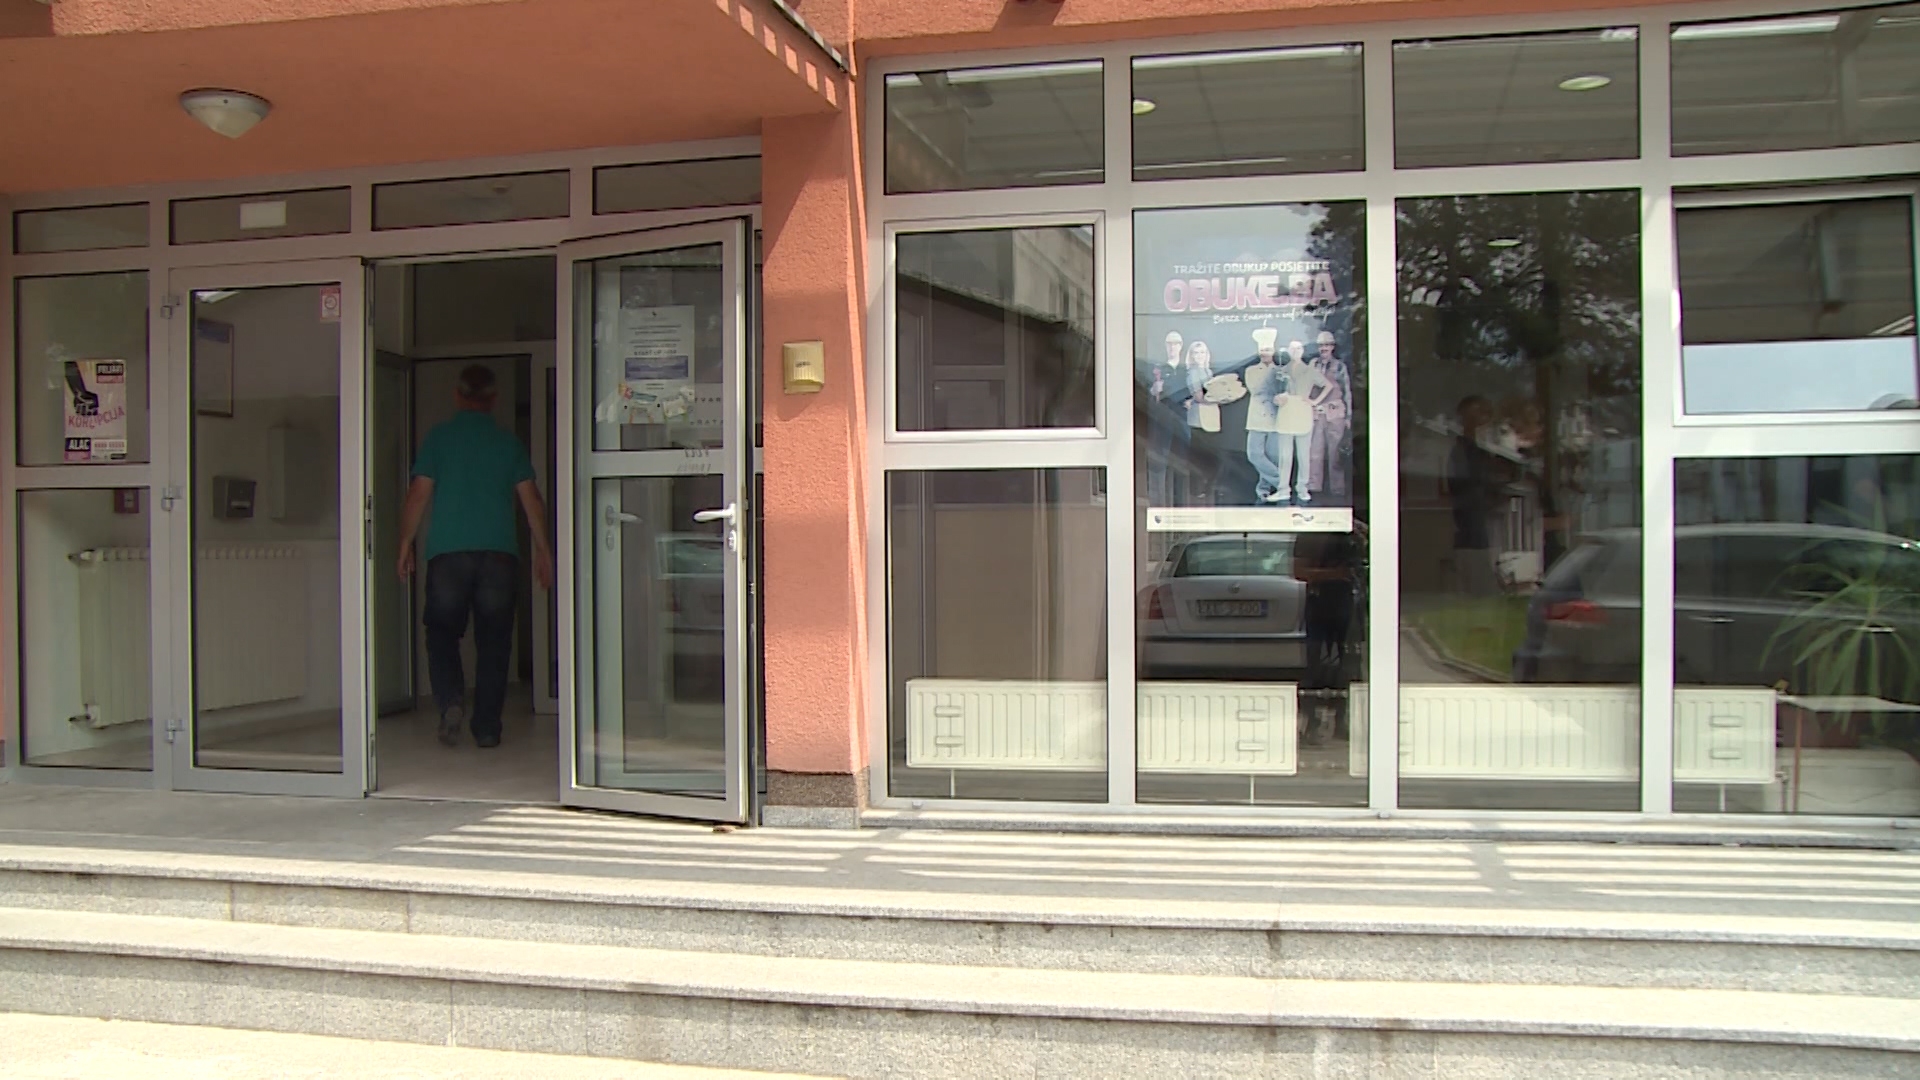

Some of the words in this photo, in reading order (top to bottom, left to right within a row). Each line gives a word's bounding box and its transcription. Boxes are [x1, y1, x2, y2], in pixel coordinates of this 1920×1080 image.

[1173, 262, 1221, 274] TRAŽITE
[1223, 262, 1268, 274] OBUKU?
[1164, 272, 1339, 312] OBUKE.BA
[69, 439, 90, 450] ALAC
